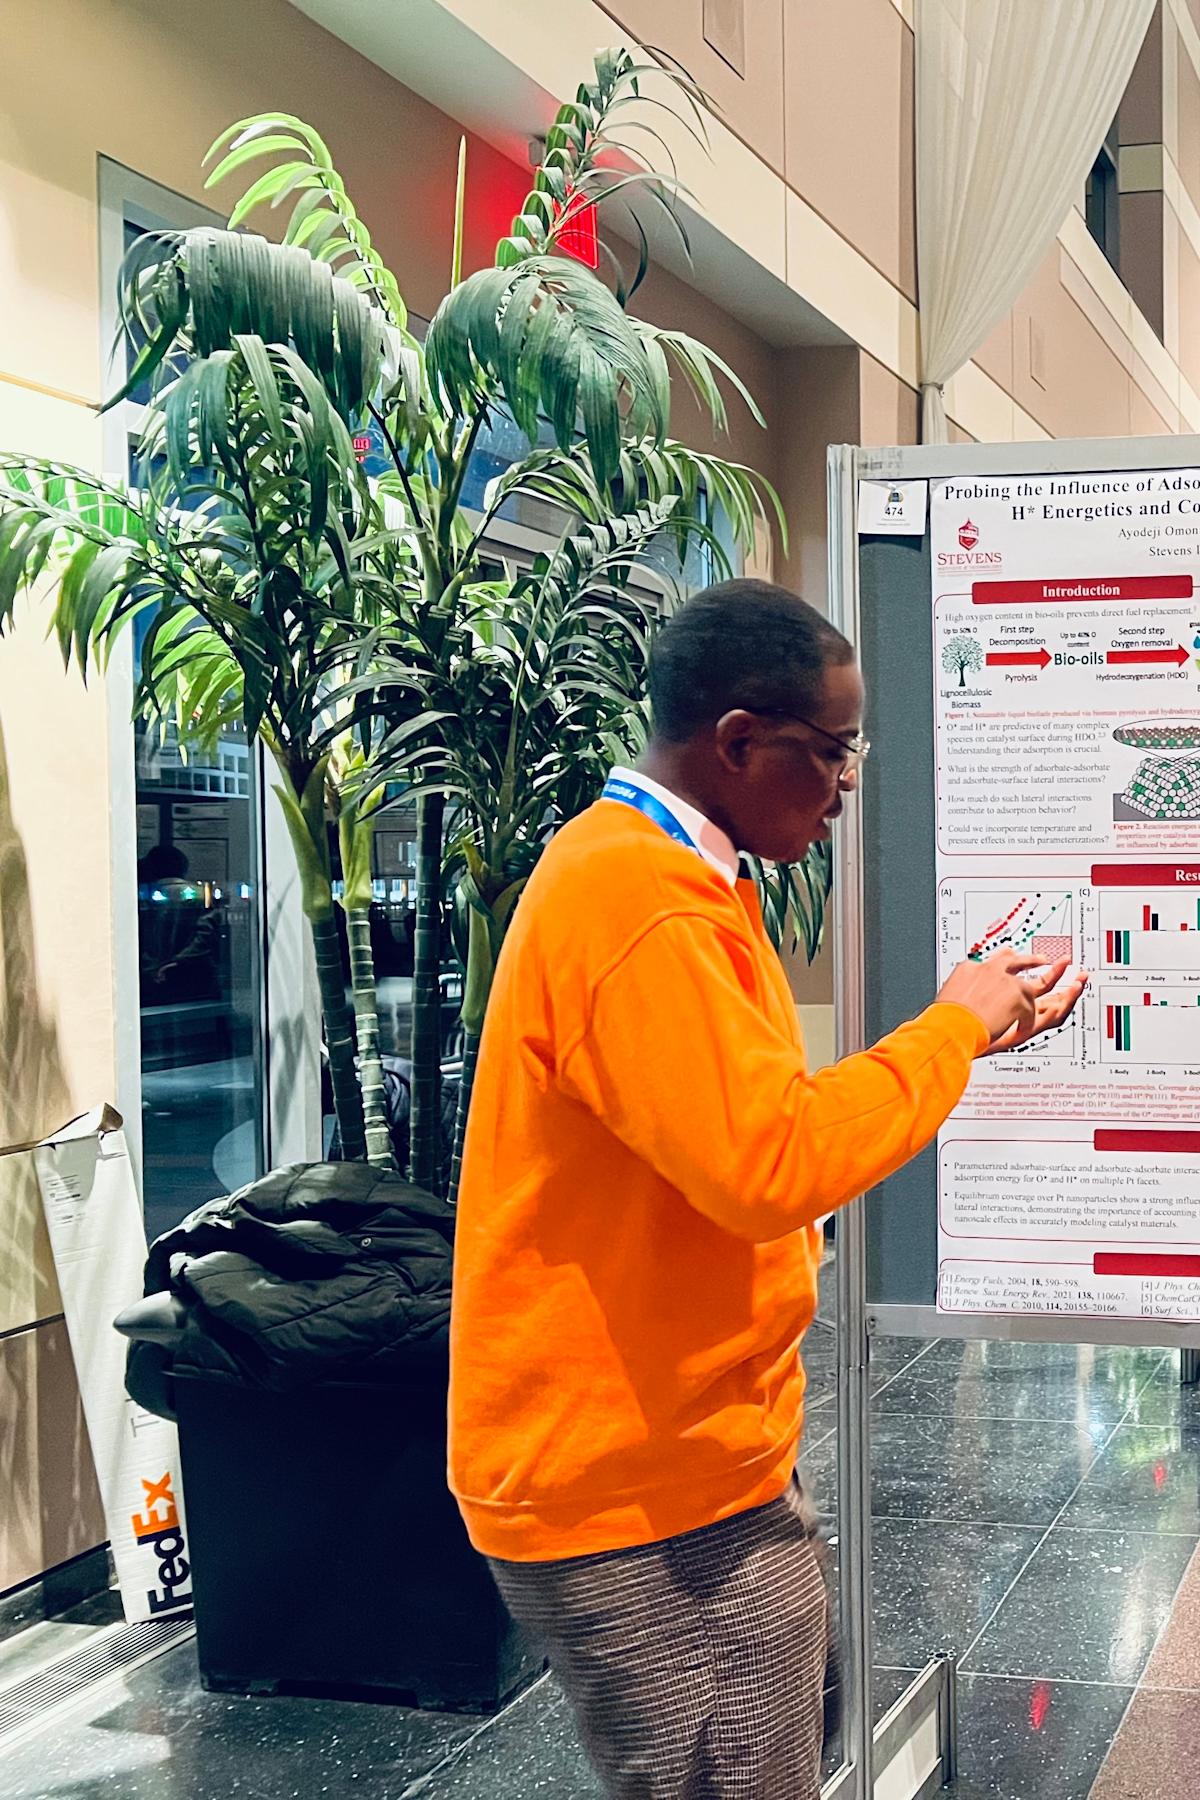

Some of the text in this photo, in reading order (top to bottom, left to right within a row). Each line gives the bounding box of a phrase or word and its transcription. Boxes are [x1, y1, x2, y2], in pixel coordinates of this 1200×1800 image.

[945, 484, 1010, 501] Probing
[1017, 482, 1042, 496] the
[1049, 480, 1129, 495] Influence
[1135, 477, 1154, 491] of
[884, 506, 903, 516] 474
[1042, 502, 1132, 521] Energetics
[1139, 499, 1170, 515] and
[1117, 526, 1160, 540] Ayodeji
[1148, 546, 1192, 556] Stevens
[937, 551, 1002, 566] STEVENS
[1042, 583, 1120, 597] Introduction
[944, 612, 963, 623] High
[964, 614, 993, 623] oxygen
[994, 612, 1023, 620] content
[1034, 609, 1064, 619] bio-oils
[1066, 610, 1100, 620] prevents
[1100, 608, 1124, 617] direct
[1125, 607, 1141, 616] fuel
[999, 625, 1034, 634] First step
[1118, 626, 1165, 635] Second step
[988, 637, 1046, 647] Decomposition
[1110, 637, 1173, 649] Oxygen removal
[1054, 651, 1104, 665] Bio-oils
[1004, 673, 1038, 683] Pyrolysis
[939, 687, 992, 699] Lignocellulosic
[951, 700, 981, 709] Biomass
[940, 888, 952, 897] (A)
[1078, 887, 1090, 897] (C)
[131, 1472, 194, 1614] FedEx
